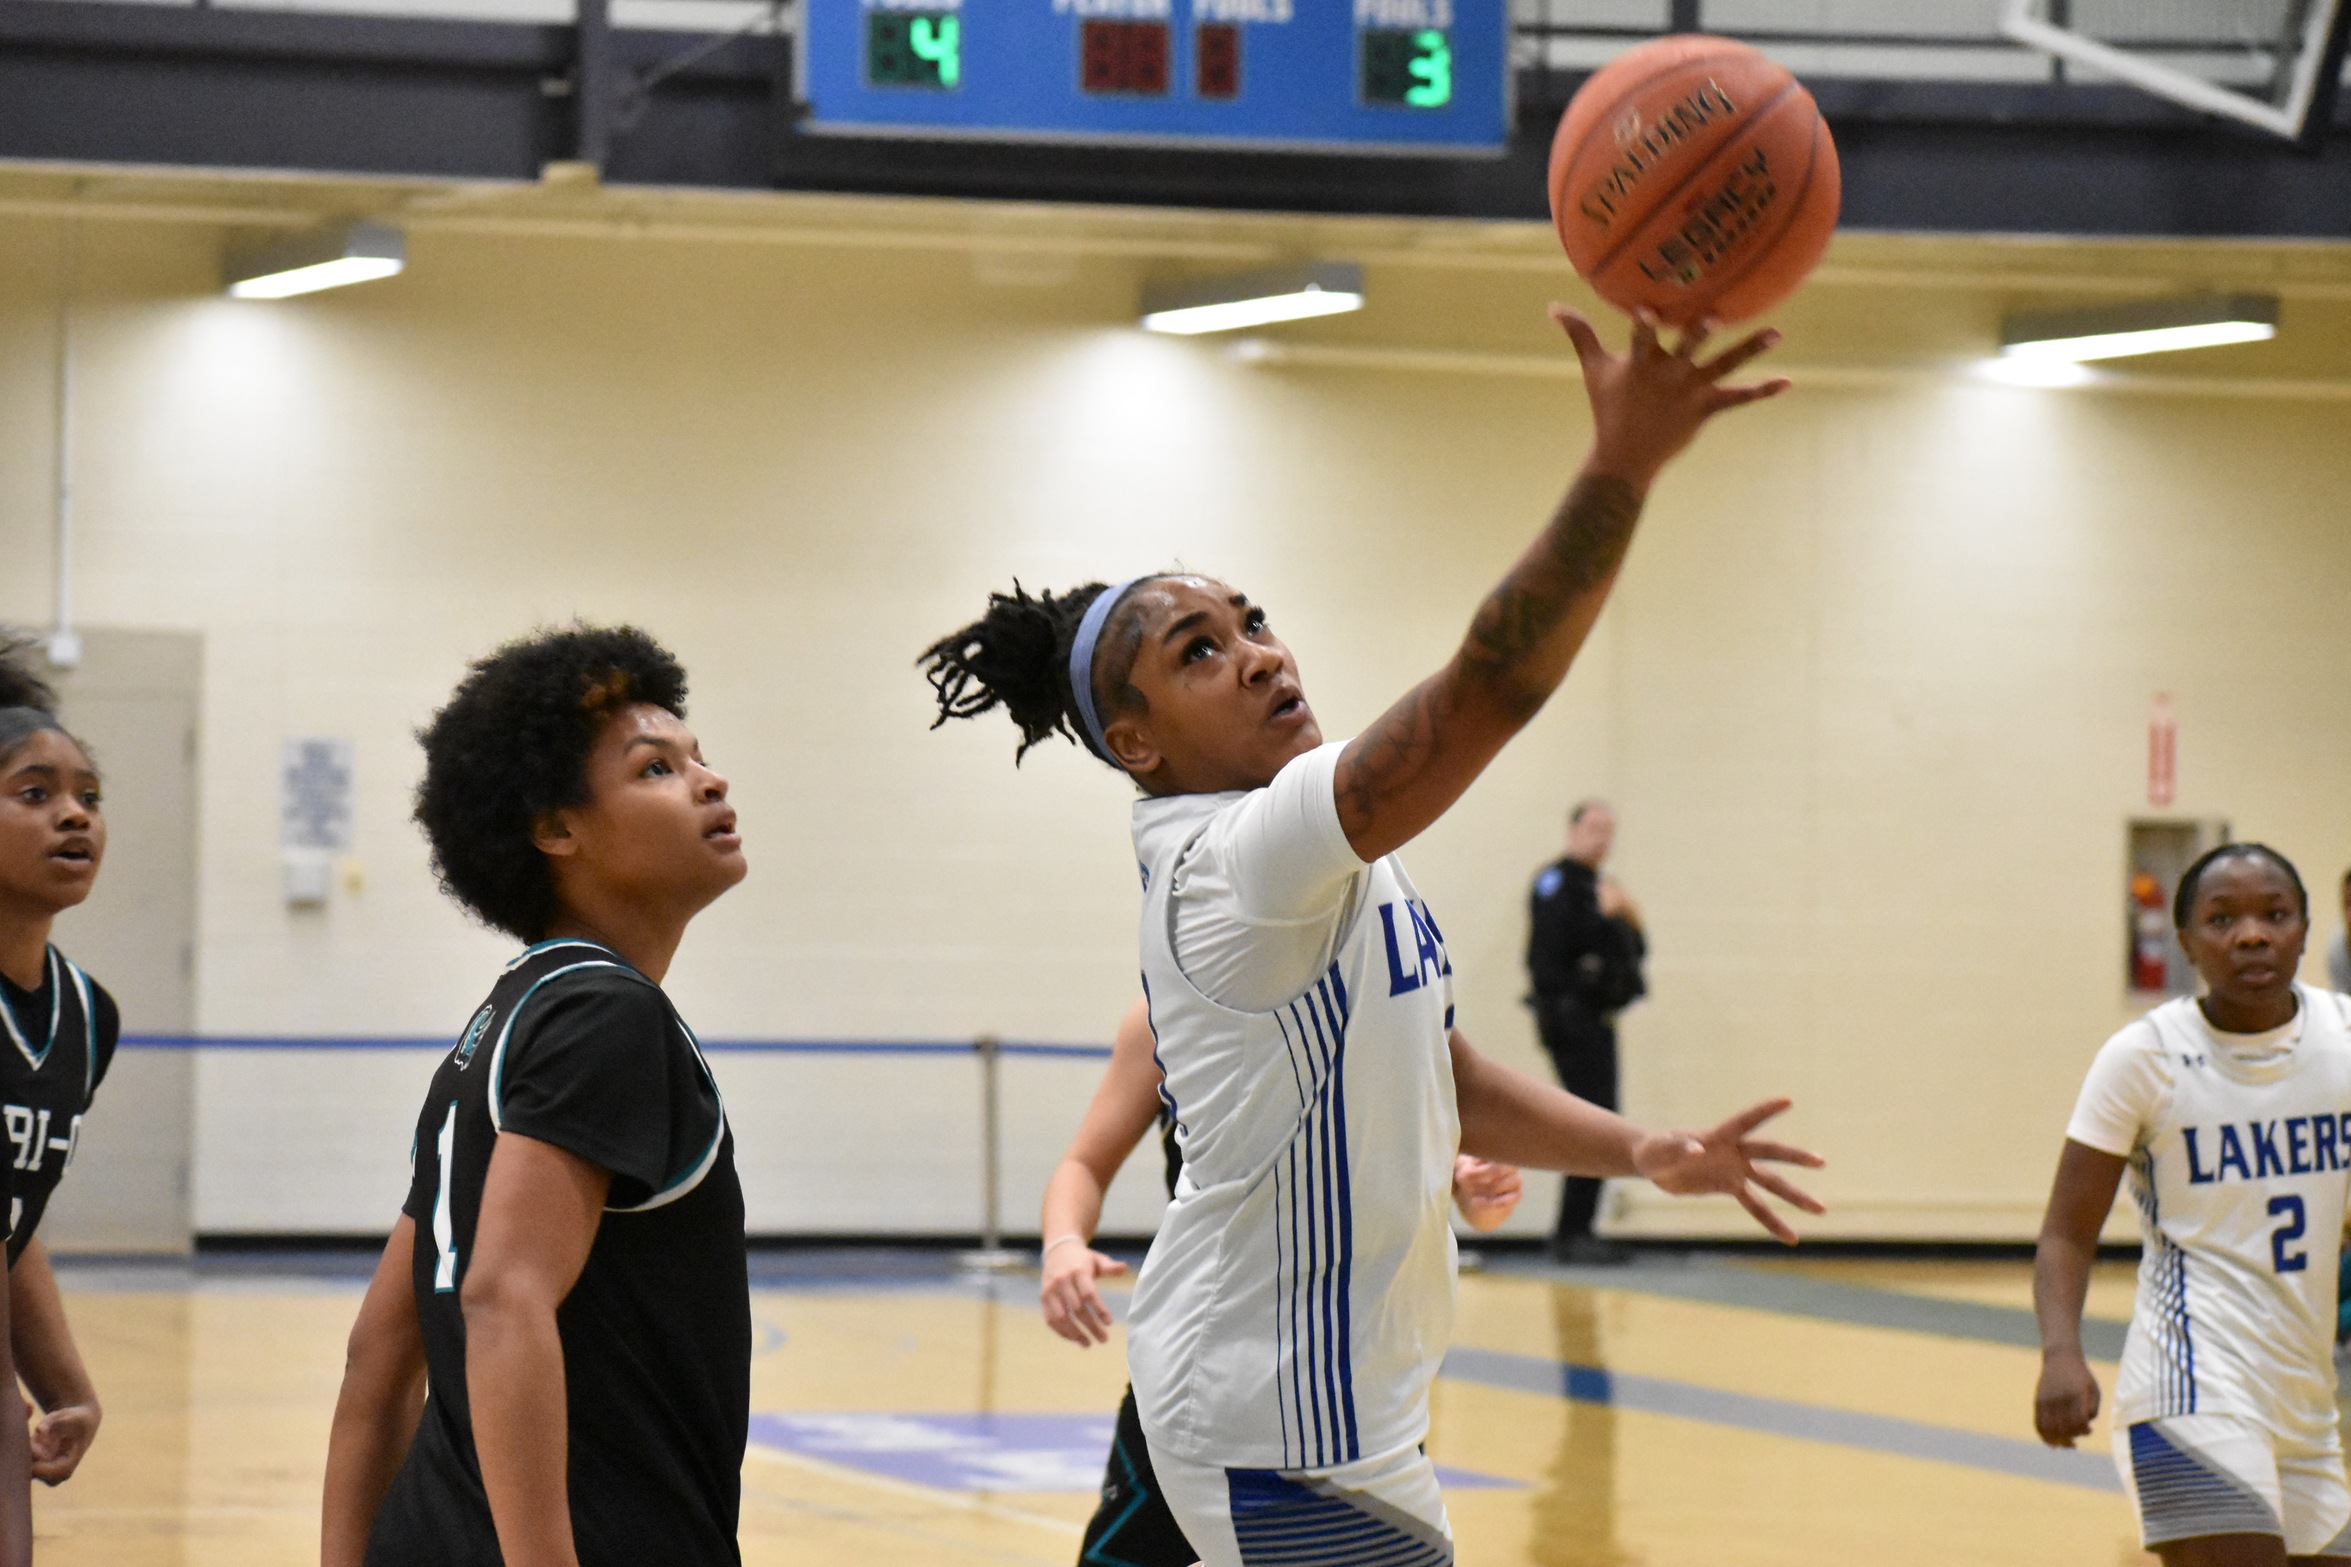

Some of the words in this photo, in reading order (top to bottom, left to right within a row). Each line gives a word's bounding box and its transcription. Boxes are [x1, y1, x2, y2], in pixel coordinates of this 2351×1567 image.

[909, 16, 959, 87] 4
[1406, 28, 1452, 107] 3
[1578, 77, 1737, 227] SPALDING
[2181, 1112, 2351, 1185] LAKERS
[2266, 1194, 2308, 1273] 2
